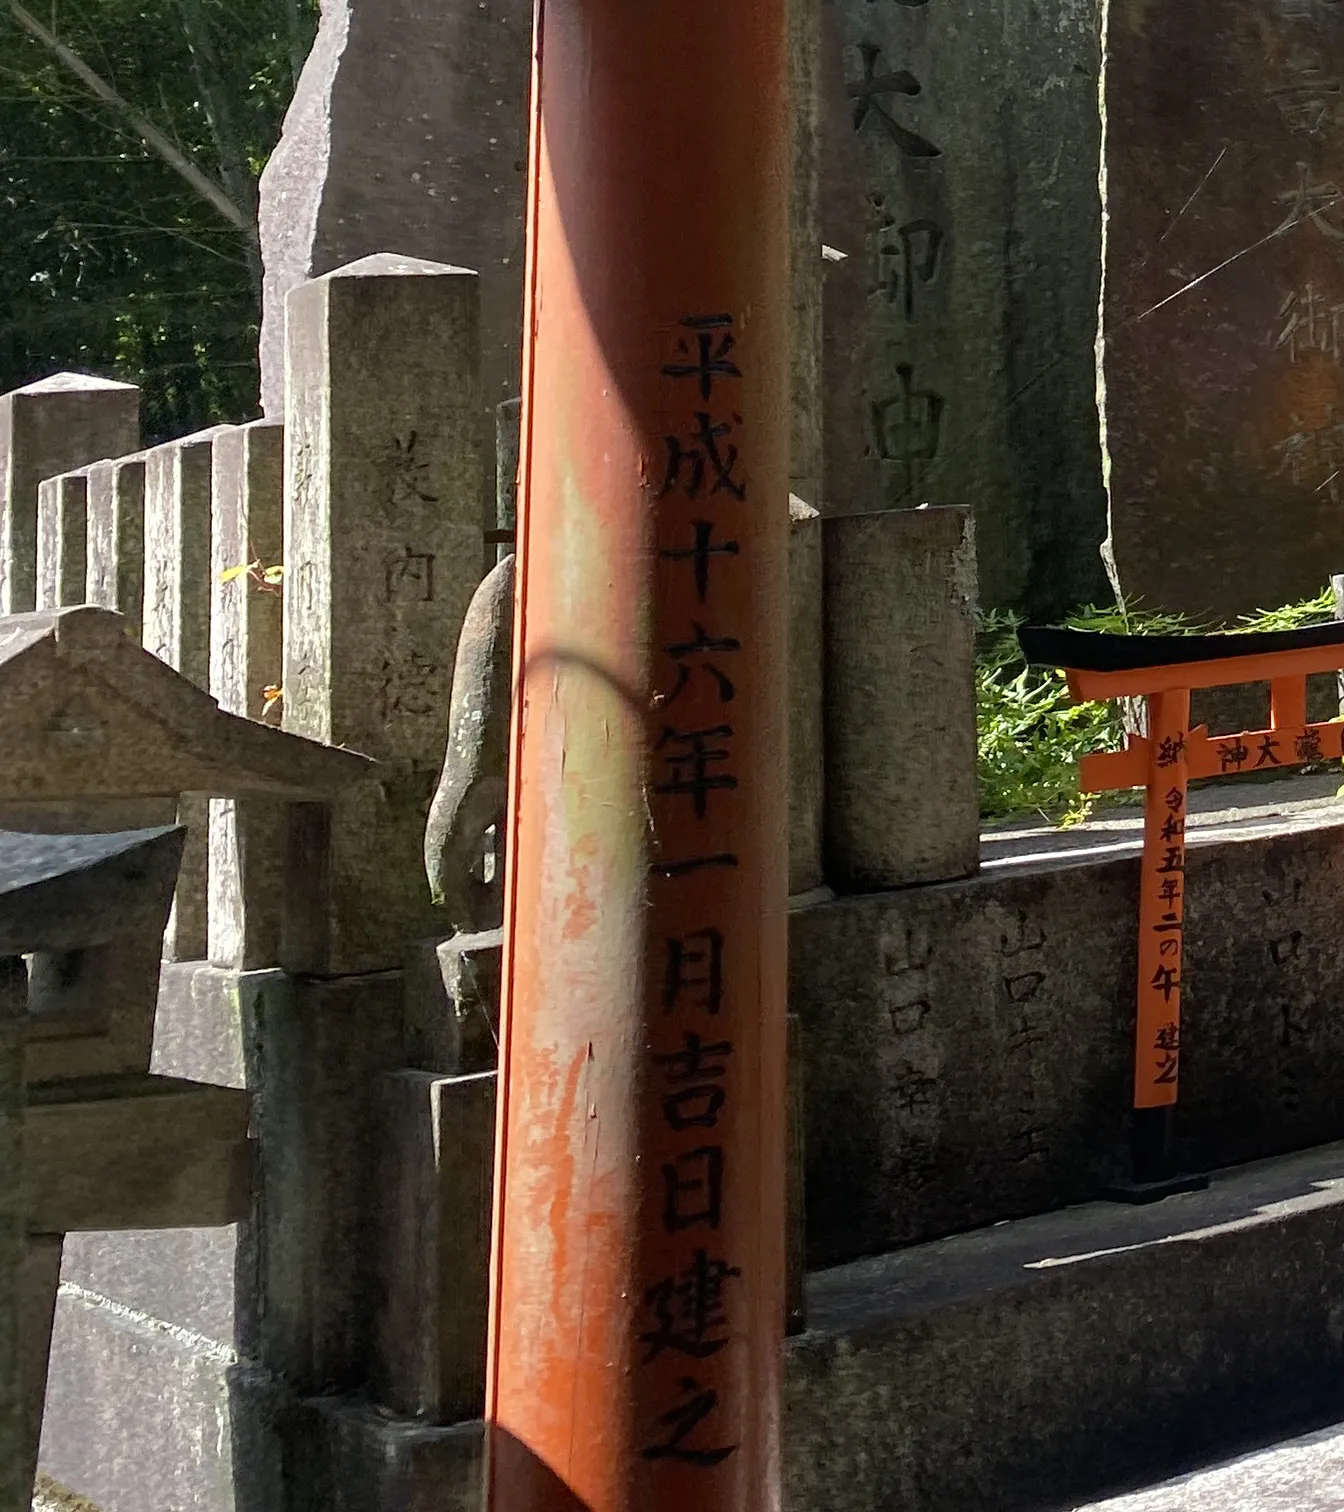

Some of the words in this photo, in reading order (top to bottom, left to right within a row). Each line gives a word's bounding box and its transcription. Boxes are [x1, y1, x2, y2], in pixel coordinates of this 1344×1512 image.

[1156, 730, 1188, 769] 納
[636, 312, 746, 1466] 平成十六年一月吉日建之
[1152, 786, 1184, 1003] 令和五年二の午
[1154, 1021, 1181, 1085] 建之
